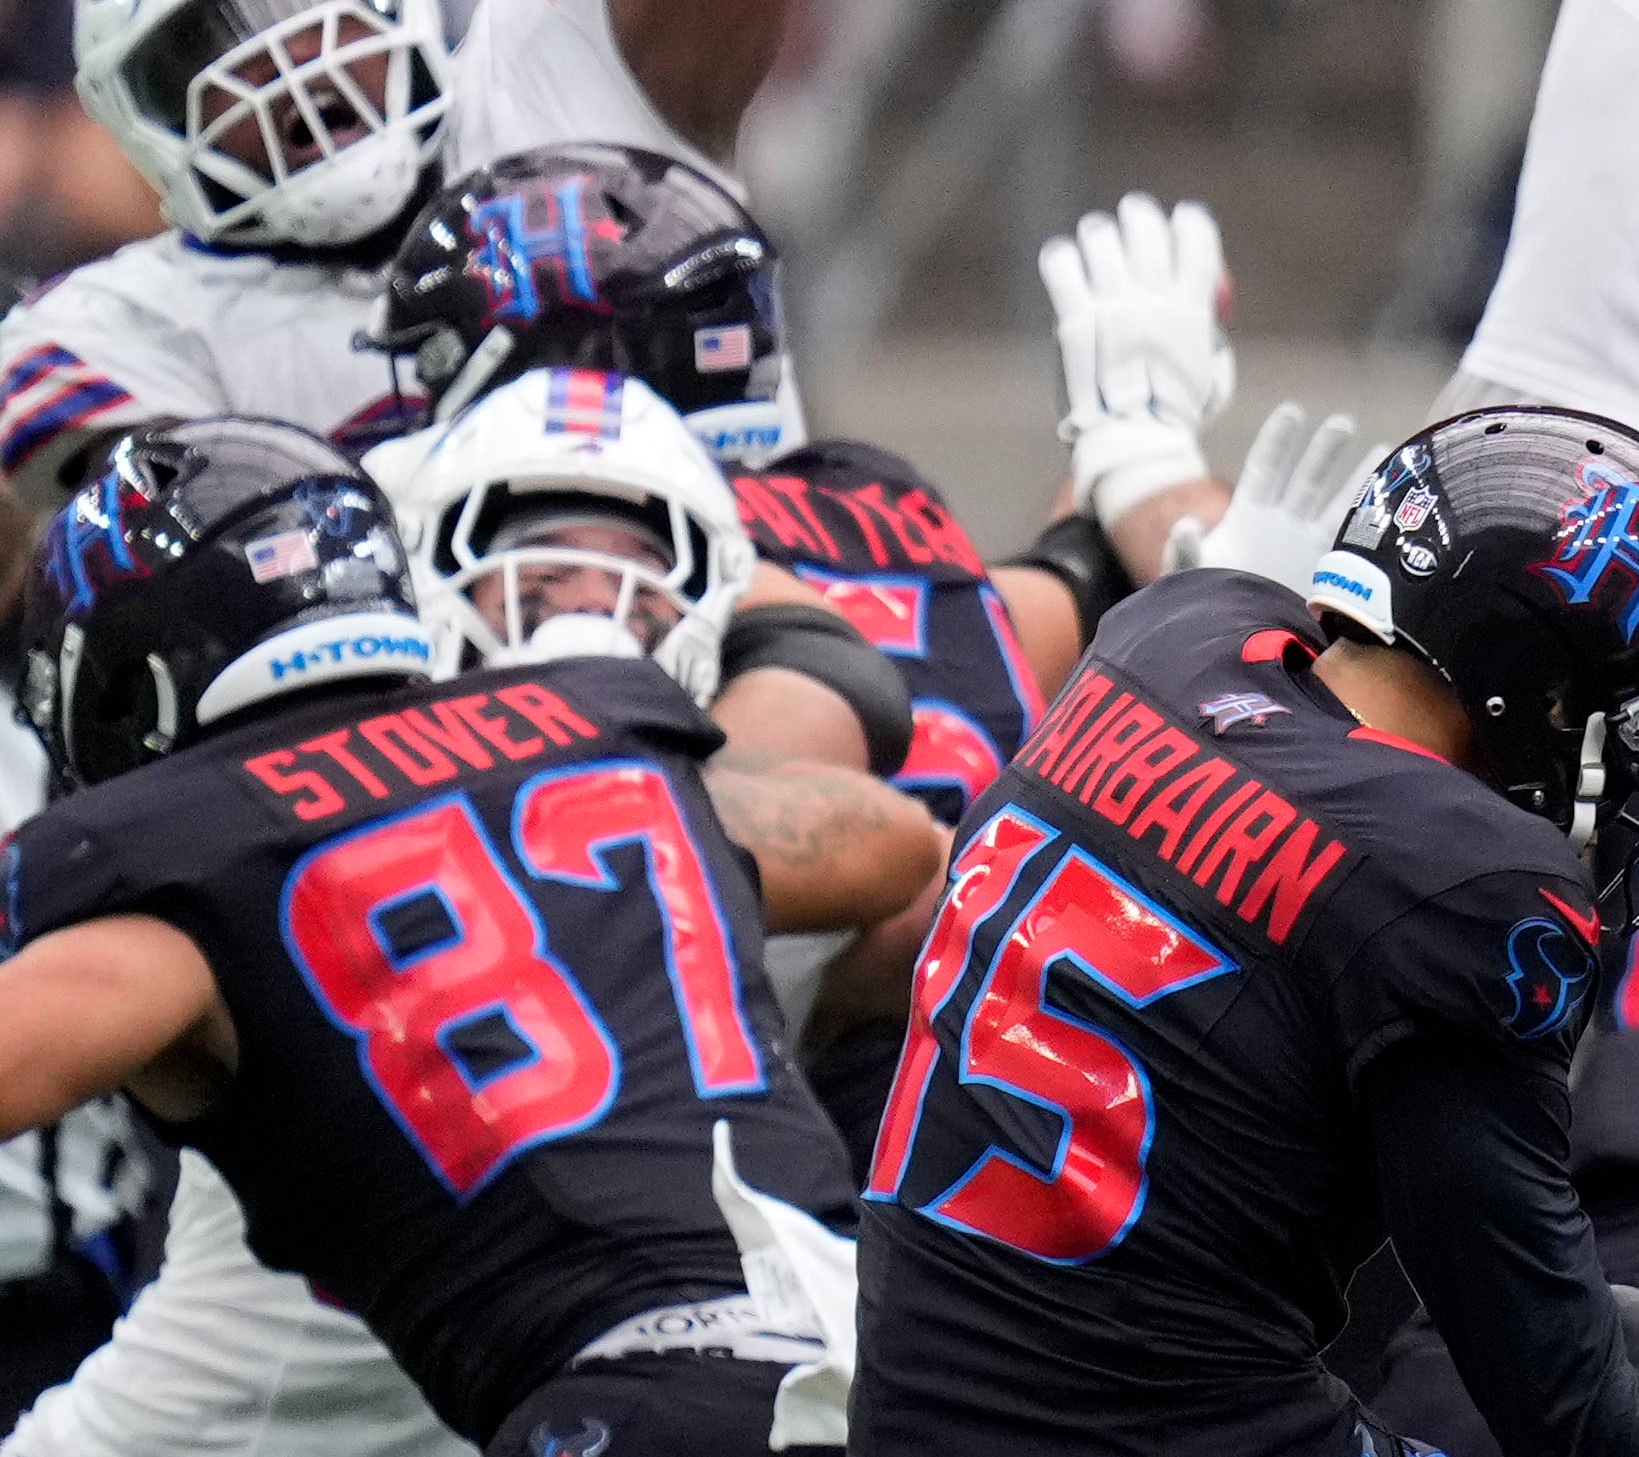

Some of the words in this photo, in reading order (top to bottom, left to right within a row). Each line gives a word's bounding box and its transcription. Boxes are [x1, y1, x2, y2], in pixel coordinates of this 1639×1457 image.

[244, 683, 600, 821] STOVER
[281, 755, 769, 1201] 87
[860, 802, 1241, 1266] 15
